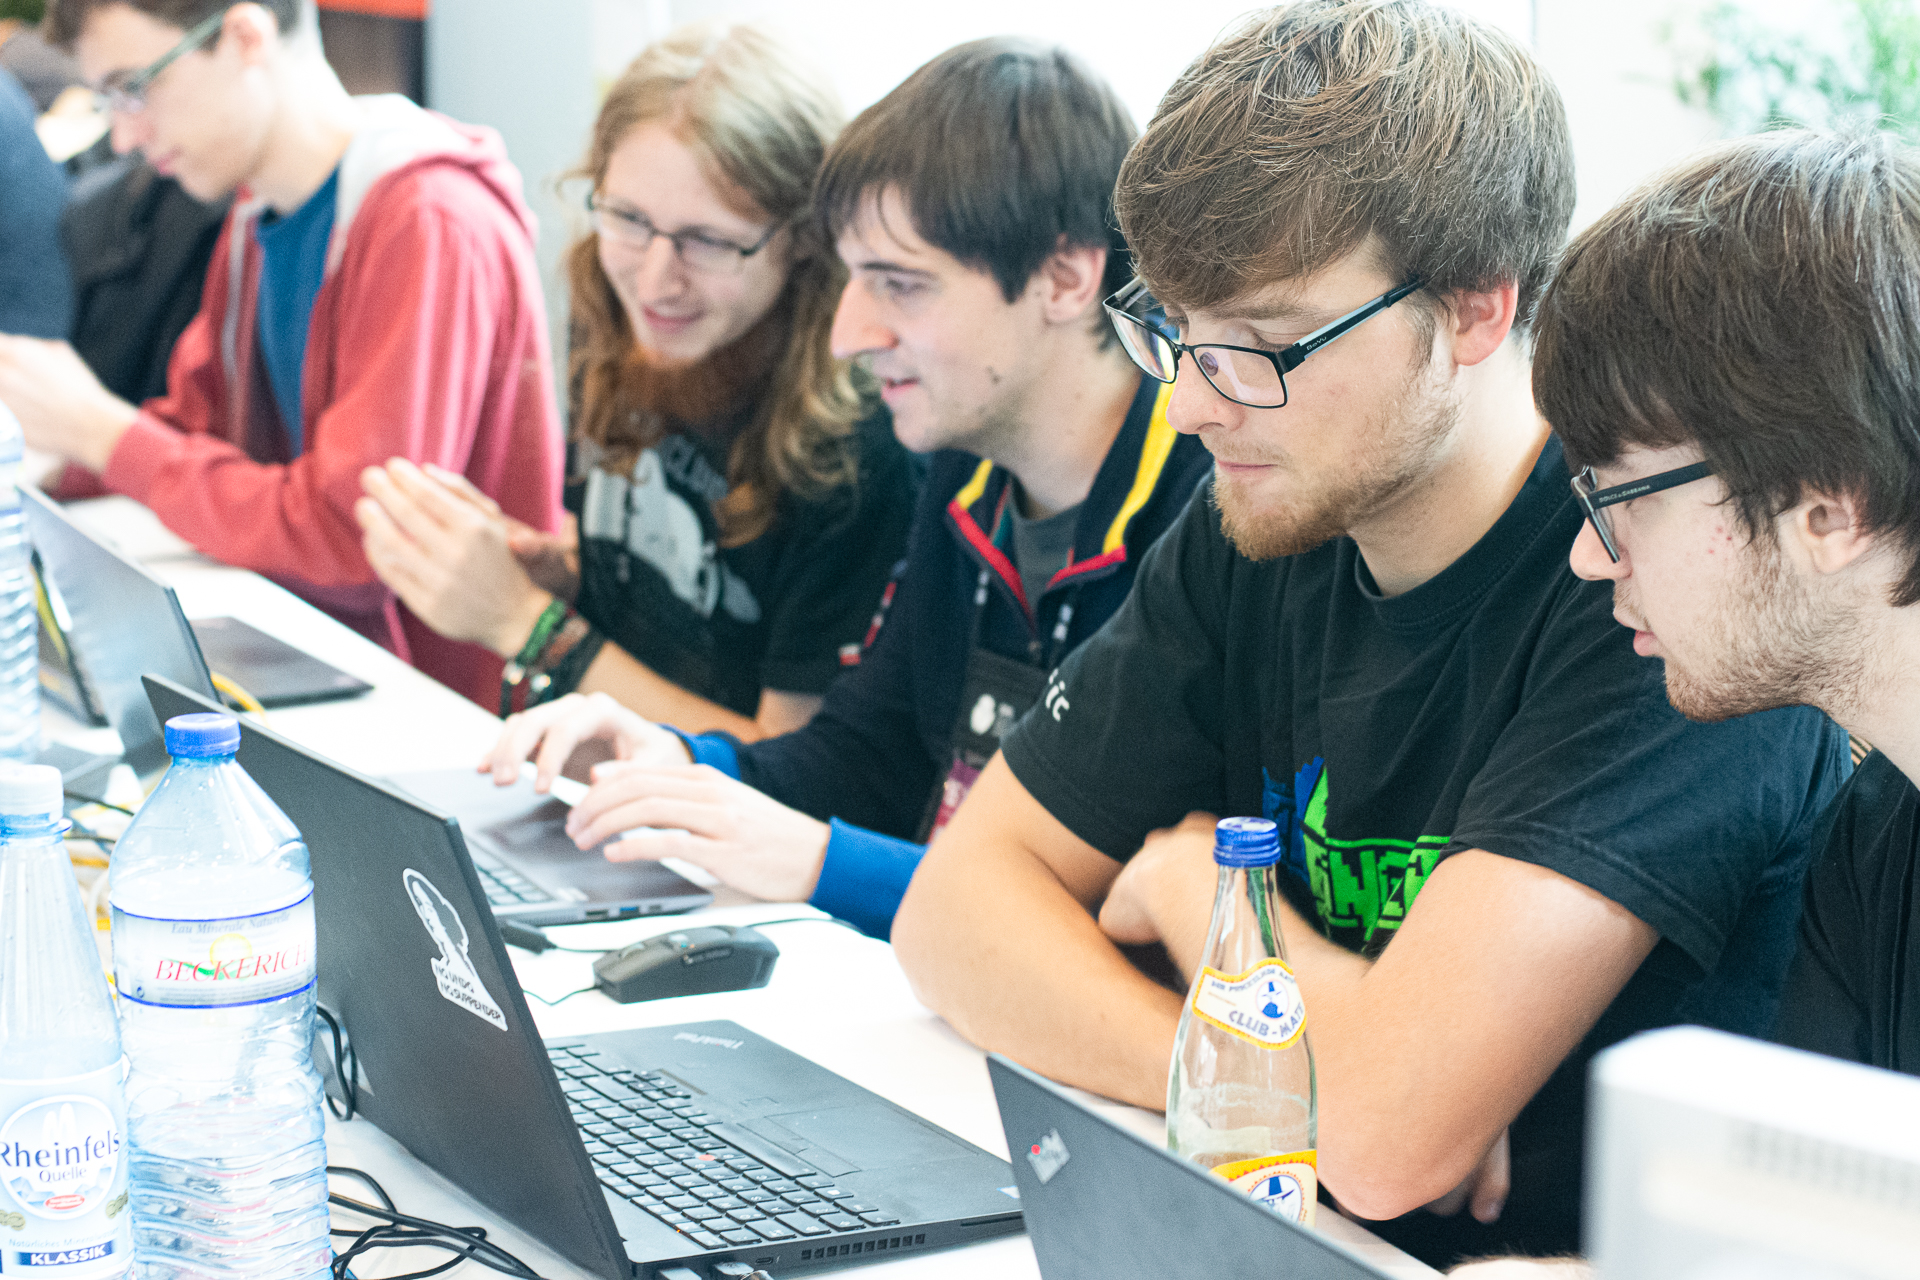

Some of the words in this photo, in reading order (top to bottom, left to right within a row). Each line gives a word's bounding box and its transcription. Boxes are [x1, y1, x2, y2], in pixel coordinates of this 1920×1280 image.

[171, 923, 193, 935] Eau
[155, 939, 307, 983] BECKERICH
[0, 1129, 120, 1168] Rheinfels
[39, 1166, 87, 1183] Quelle
[30, 1244, 106, 1266] KLASSIK
